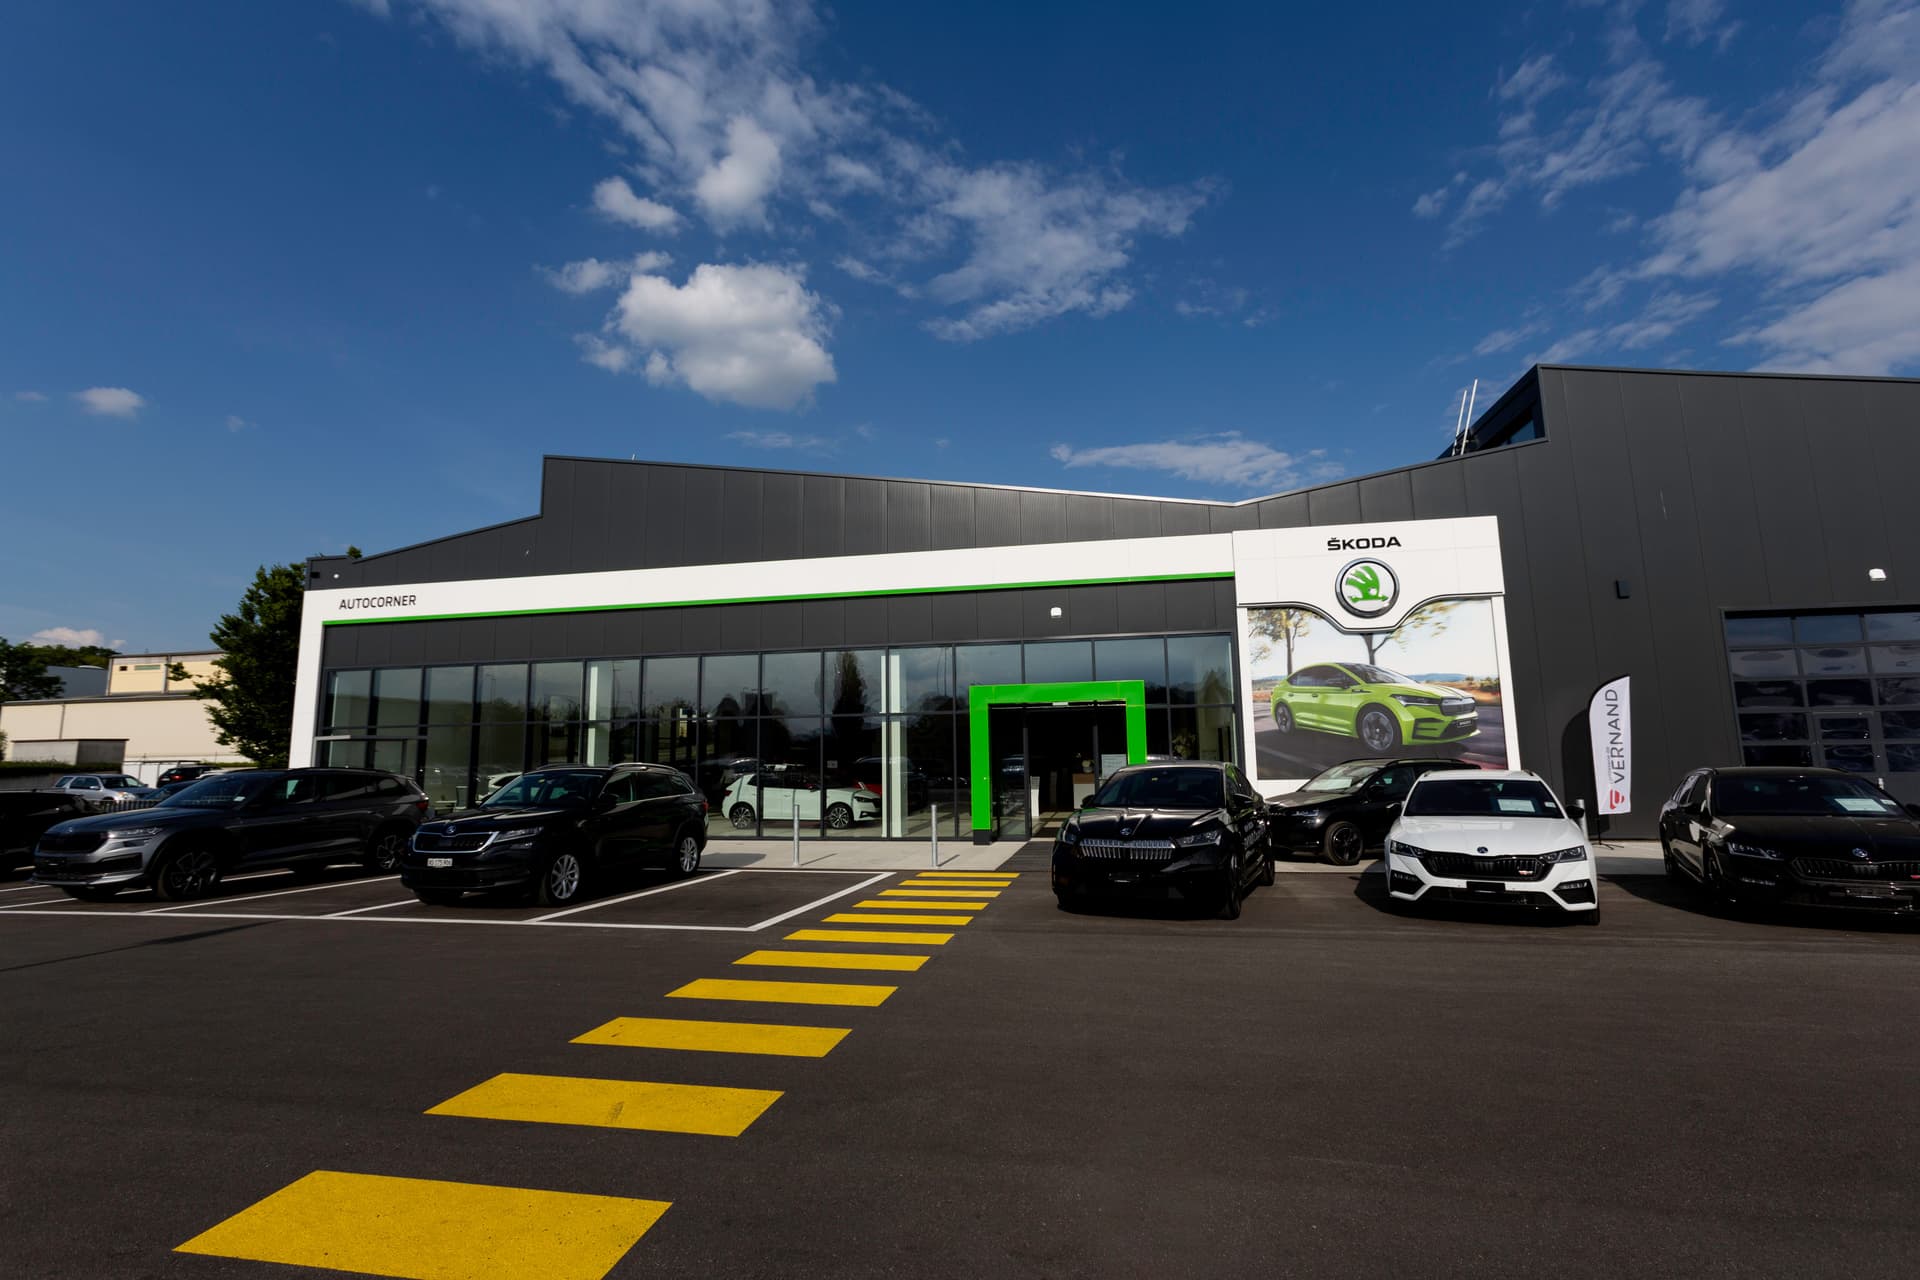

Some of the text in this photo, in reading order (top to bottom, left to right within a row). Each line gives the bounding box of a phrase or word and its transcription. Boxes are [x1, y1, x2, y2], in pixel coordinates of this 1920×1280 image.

[1327, 536, 1402, 551] ŠKODA
[338, 594, 417, 610] AUTOCORNER
[1605, 689, 1625, 784] VERNAND
